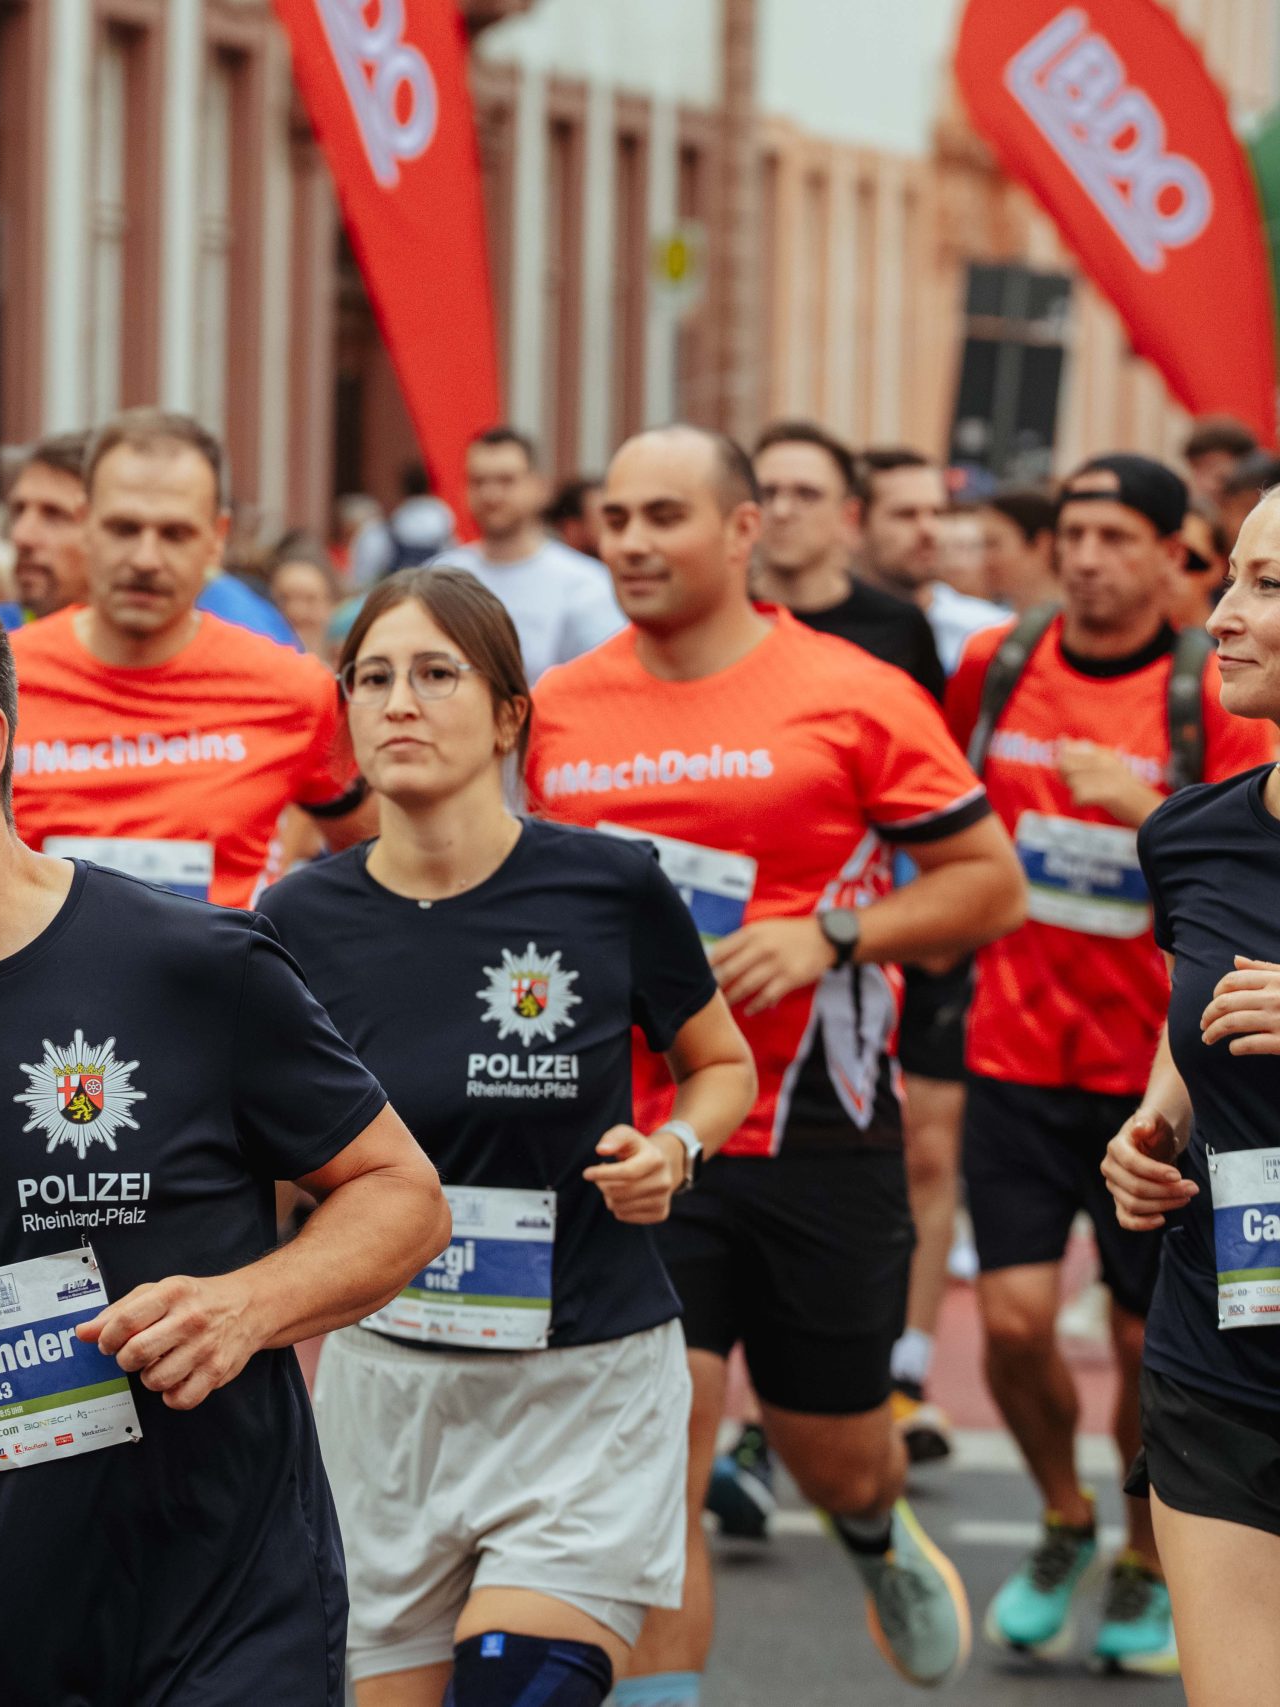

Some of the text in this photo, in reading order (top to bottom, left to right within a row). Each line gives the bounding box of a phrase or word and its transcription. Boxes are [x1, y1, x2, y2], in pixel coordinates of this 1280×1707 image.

[467, 1053, 579, 1079] POLIZEI
[466, 1080, 579, 1098] Rheinland-Pfalz
[18, 1172, 151, 1208] POLIZEI
[22, 1206, 147, 1233] Rheinland-Pfalz
[11, 1405, 24, 1416] UHR
